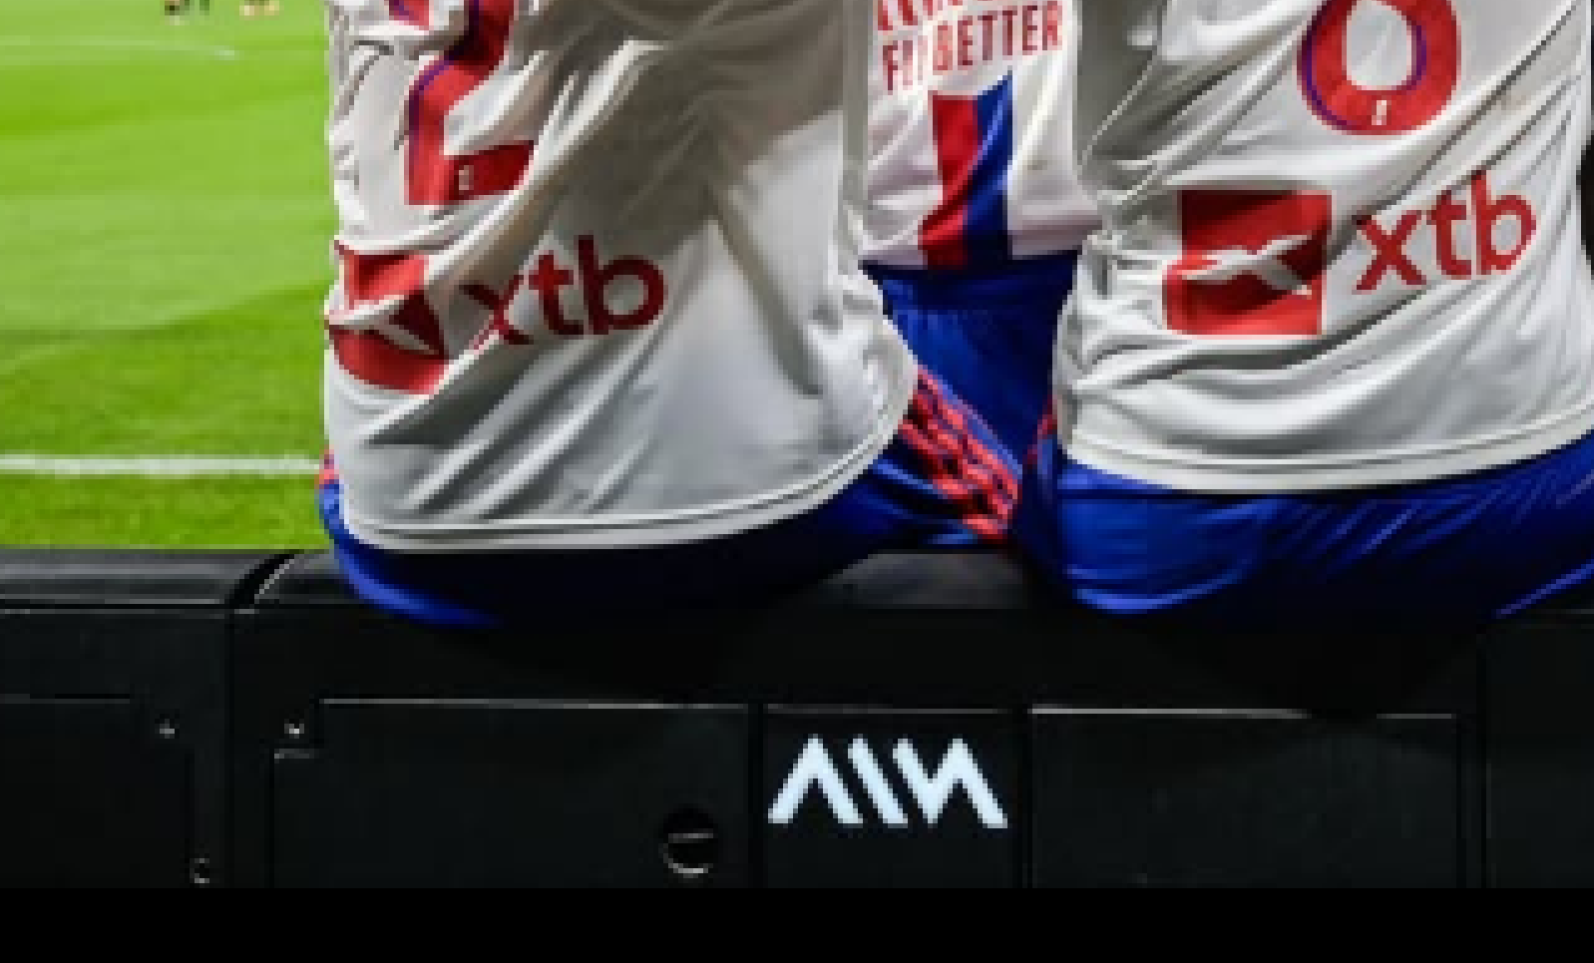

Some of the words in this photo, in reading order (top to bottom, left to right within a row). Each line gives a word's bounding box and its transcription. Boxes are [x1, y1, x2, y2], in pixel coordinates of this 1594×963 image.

[931, 0, 1064, 76] BETTER
[1352, 170, 1537, 292] xtb
[460, 235, 667, 350] xtb
